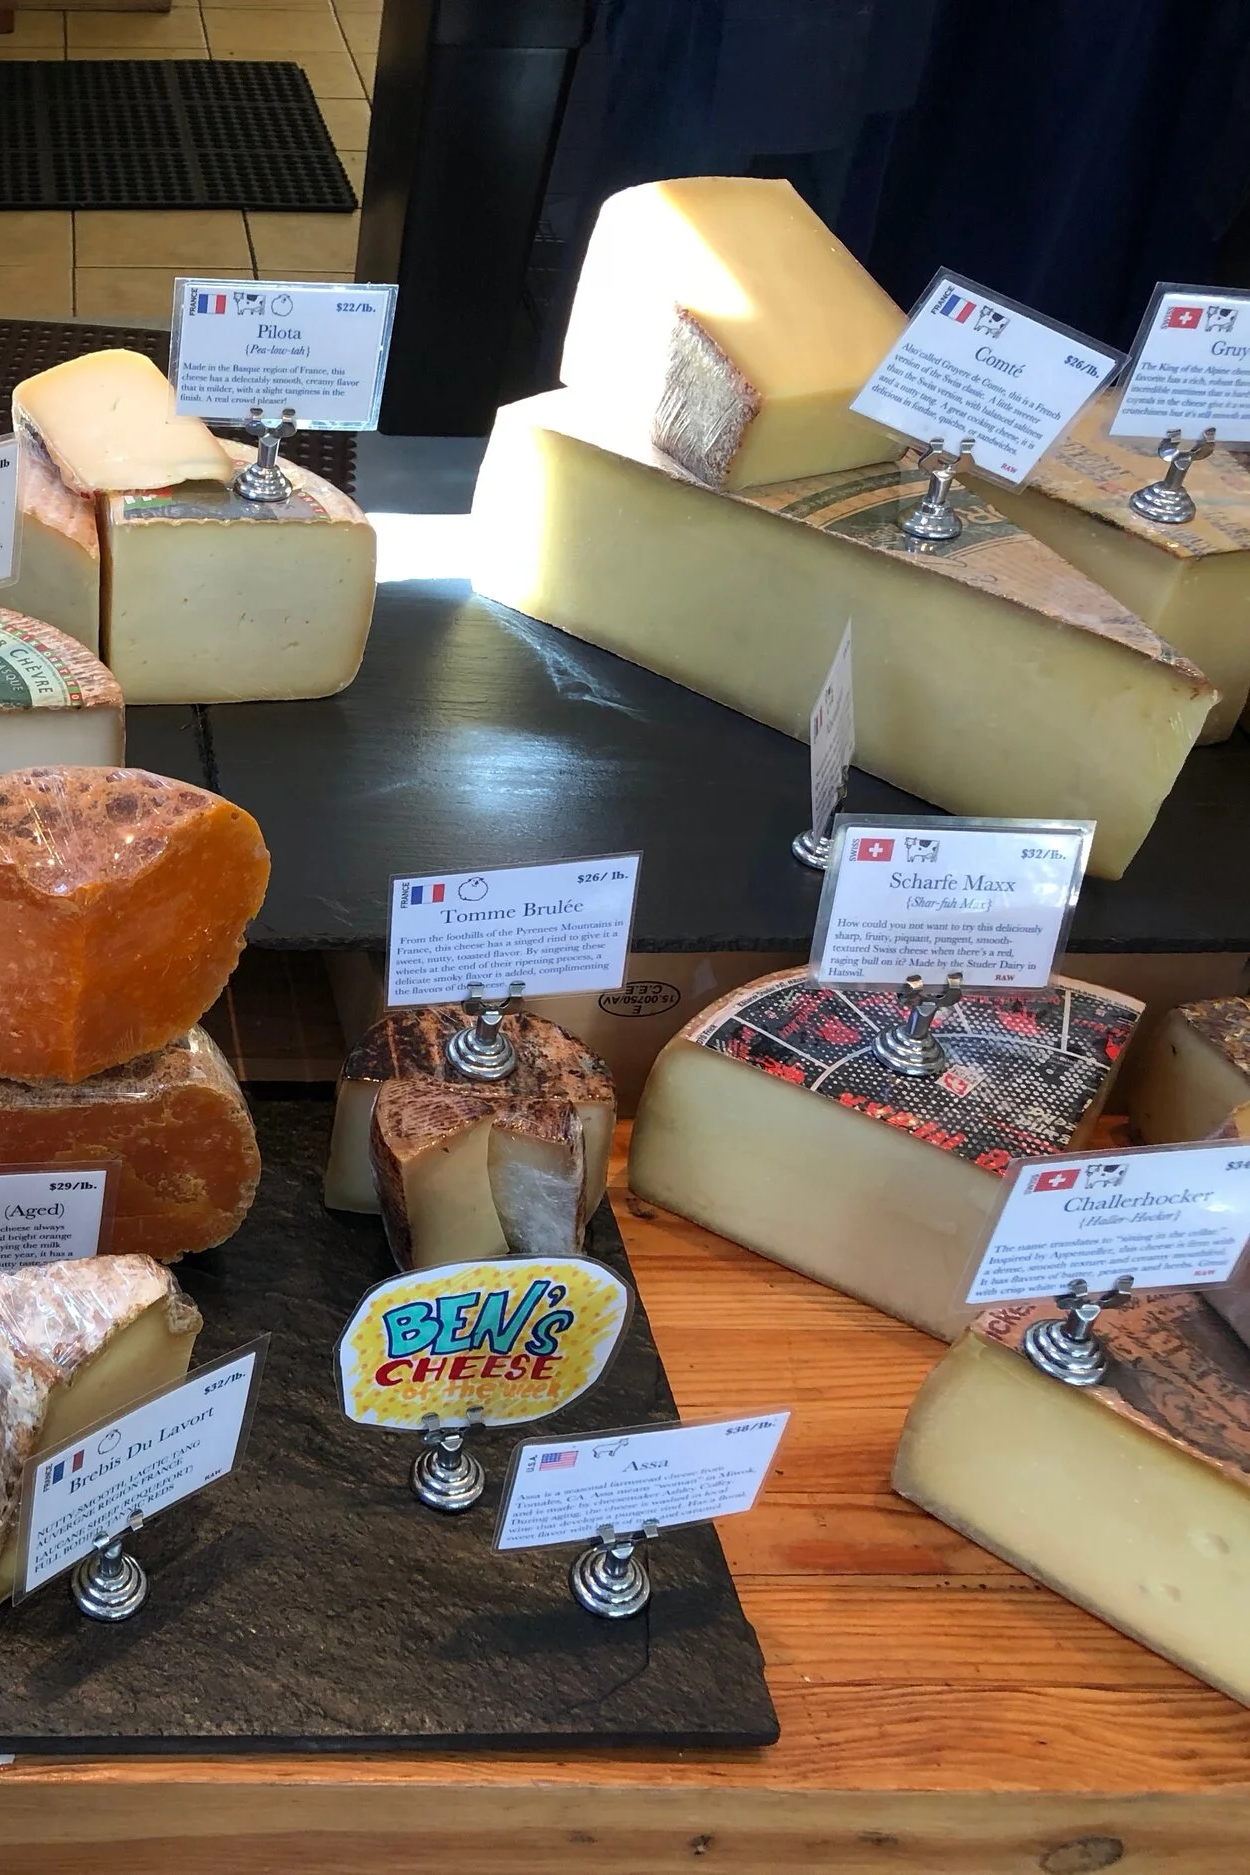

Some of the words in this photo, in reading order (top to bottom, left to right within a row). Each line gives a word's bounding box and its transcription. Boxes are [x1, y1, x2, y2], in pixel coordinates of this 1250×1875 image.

[189, 288, 198, 316] FRANCE
[336, 302, 376, 313] $22/lb.
[930, 285, 955, 315] FRANCE
[257, 324, 301, 340] Pilota
[245, 343, 310, 358] {Pea-low-tah}
[182, 361, 206, 371] Made
[207, 363, 216, 372] in
[217, 363, 231, 372] the
[232, 363, 261, 375] Basque
[262, 365, 288, 375] region
[288, 365, 299, 374] of
[299, 365, 329, 376] France,
[330, 367, 346, 376] this
[974, 346, 1025, 378] Comté
[1064, 355, 1099, 378] $26/lb.
[1000, 462, 1018, 474] RAW
[9, 648, 54, 695] CHÈVRE
[849, 838, 859, 861] SWISS
[577, 872, 607, 884] $26/
[611, 870, 629, 880] lb.
[889, 872, 957, 890] Scharfe
[963, 874, 1016, 892] Maxx
[401, 881, 410, 909] FRANCE
[906, 895, 957, 911] {Shar-fuh
[440, 908, 516, 924] Tomme
[523, 899, 583, 917] Brulée
[399, 936, 426, 945] From
[428, 934, 444, 943] the
[446, 930, 484, 941] foothills
[485, 928, 497, 938] of
[497, 928, 514, 937] the
[516, 926, 558, 936] Pyrenees
[560, 921, 612, 931] Mountains
[613, 919, 624, 927] in
[837, 917, 860, 928] How
[861, 919, 888, 929] could
[888, 922, 907, 931] you
[907, 922, 924, 930] not
[926, 923, 949, 931] want
[950, 923, 961, 931] to
[961, 923, 975, 933] try
[976, 922, 994, 932] this
[995, 923, 1043, 935] deliciously
[632, 1004, 642, 1014] E
[49, 1181, 97, 1191] $29/lb.
[4, 1202, 65, 1220] (Aged)
[0, 1225, 31, 1233] cheese
[33, 1223, 65, 1232] always
[375, 1355, 563, 1386] CHEESE
[204, 1372, 246, 1395] $32/lb.
[402, 1380, 430, 1400] of
[442, 1378, 493, 1399] the
[70, 1457, 121, 1493] Brebis
[127, 1439, 152, 1460] Du
[159, 1407, 215, 1442] Lavort
[622, 1459, 669, 1473] Assa
